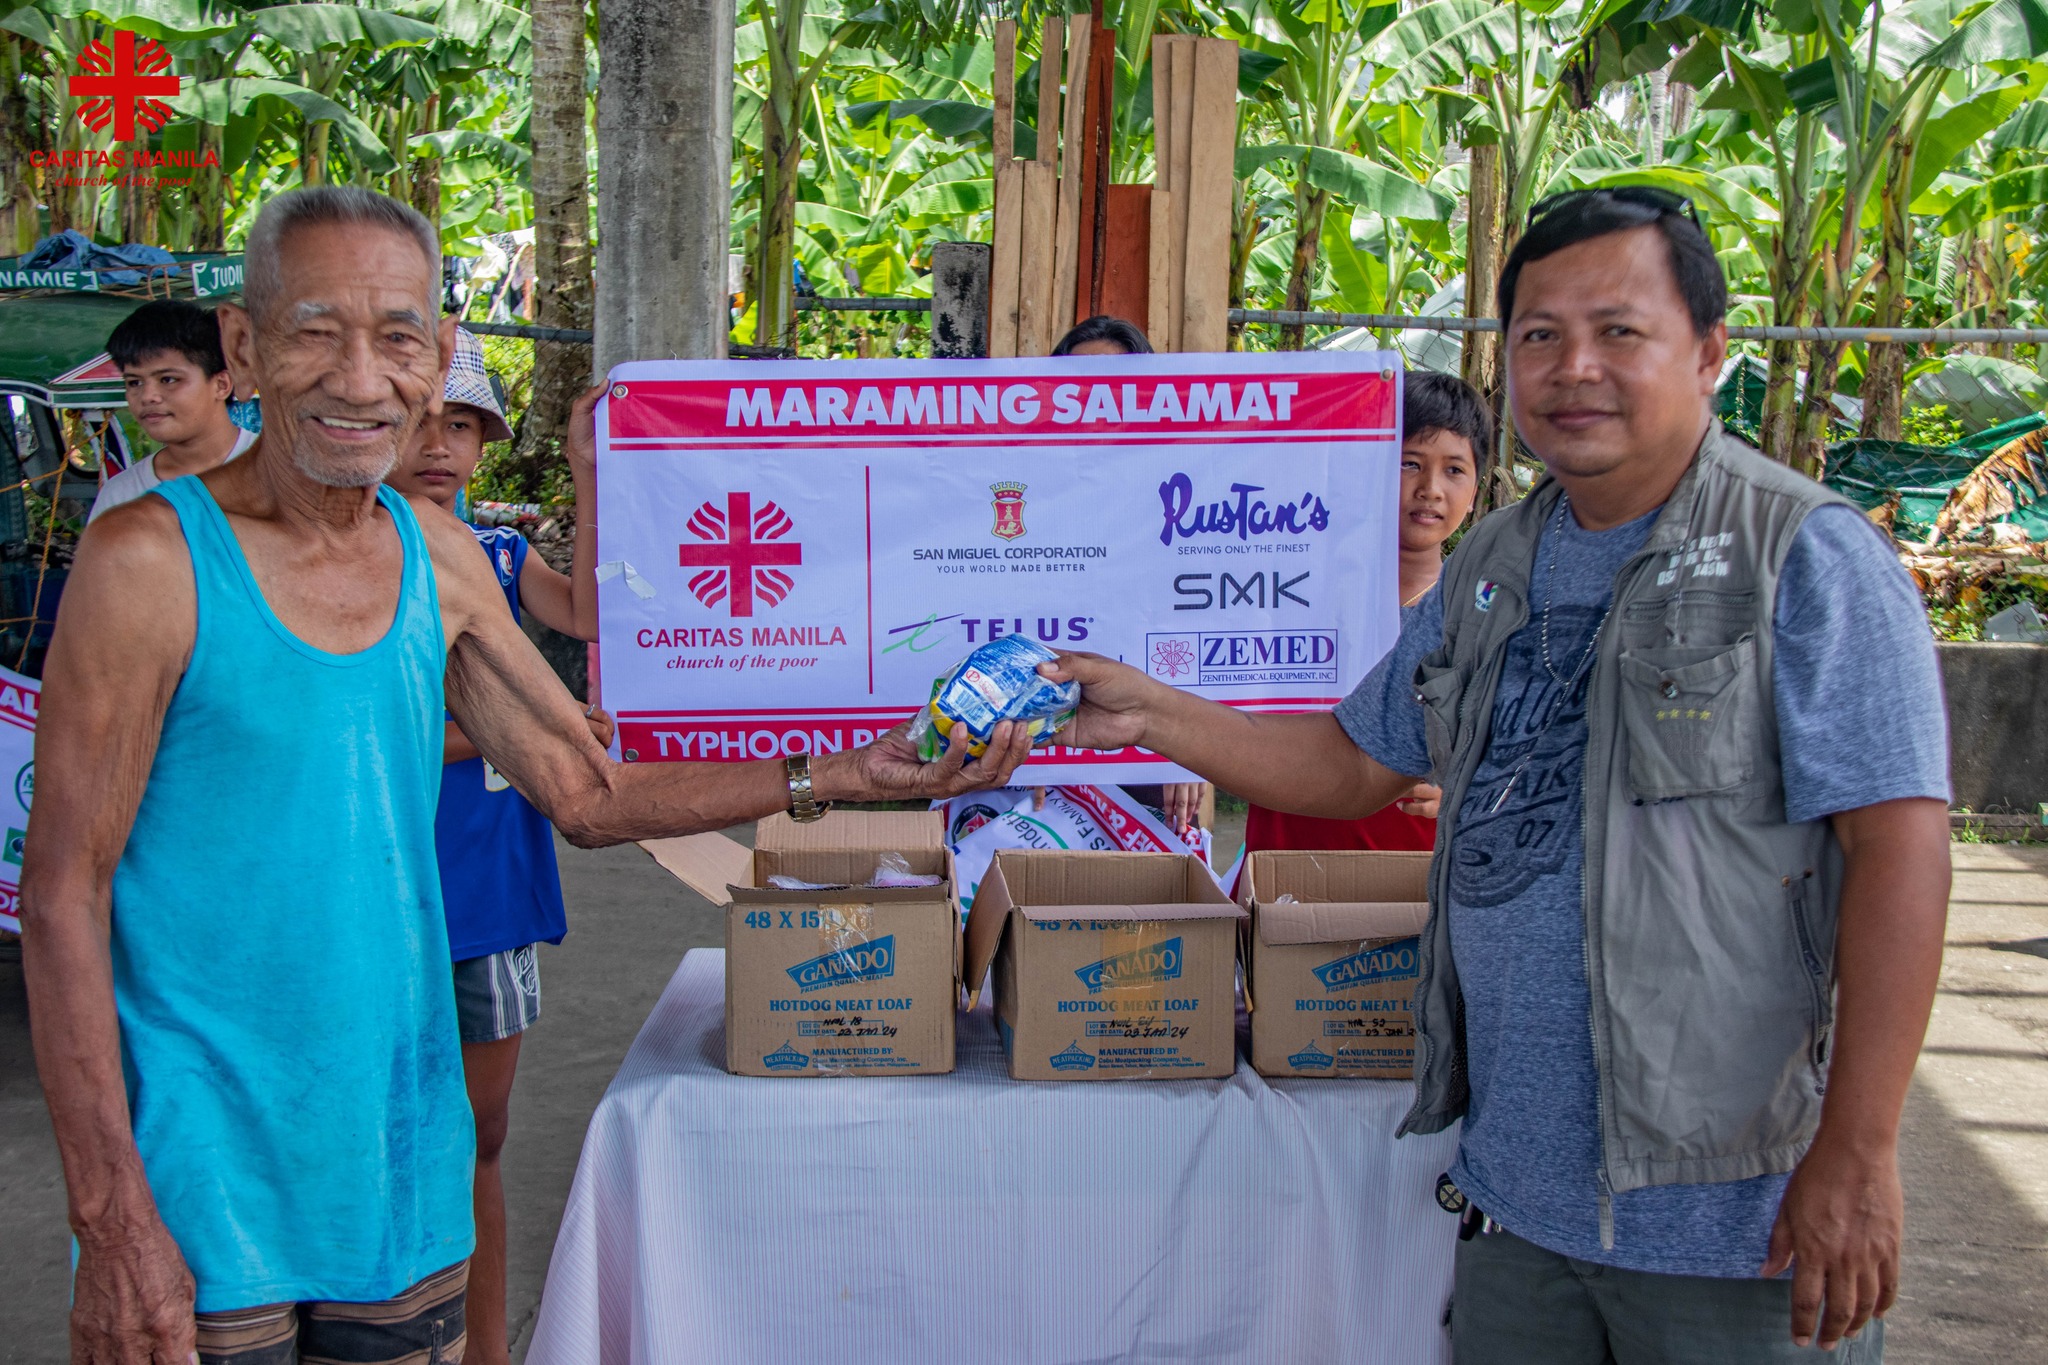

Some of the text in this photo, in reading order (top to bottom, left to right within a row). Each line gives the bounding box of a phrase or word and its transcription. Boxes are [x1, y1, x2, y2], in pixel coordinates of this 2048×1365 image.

[725, 380, 1298, 428] MARAMING SALAMAT
[912, 546, 1107, 561] SAN MIGUEL CORPORATION
[1177, 543, 1310, 555] SERVING ONLY THE FINEST
[936, 563, 1086, 574] YOUR WORLD MADE BETTER
[1173, 571, 1310, 611] SMK
[636, 626, 847, 648] CARITAS MANILA
[1202, 635, 1335, 667] ZEMED
[666, 653, 819, 672] church of the poor
[1201, 672, 1335, 682] ZENITH MEDICAL EQUIPMENT, INC.
[652, 729, 842, 759] TYPHOON
[1515, 818, 1557, 849] 07
[744, 911, 772, 929] 48
[779, 911, 794, 929] X
[800, 947, 889, 984] GANADO
[1325, 948, 1415, 983] GANADO
[769, 998, 913, 1012] HOTDOG MEAT LOAF
[1057, 999, 1199, 1013] HOTDOG MEAT LOAF
[1295, 1000, 1357, 1011] HOTDOG
[1360, 1000, 1398, 1011] MEAT
[1170, 1026, 1190, 1039] 24
[1408, 1027, 1416, 1037] 2
[812, 1048, 879, 1056] MANUFACTURED
[1098, 1047, 1165, 1056] MANUFACTURED
[1336, 1048, 1404, 1056] MANUFACTURED
[1051, 1054, 1094, 1065] MEATPACKING
[1290, 1053, 1333, 1065] MEATPACKING
